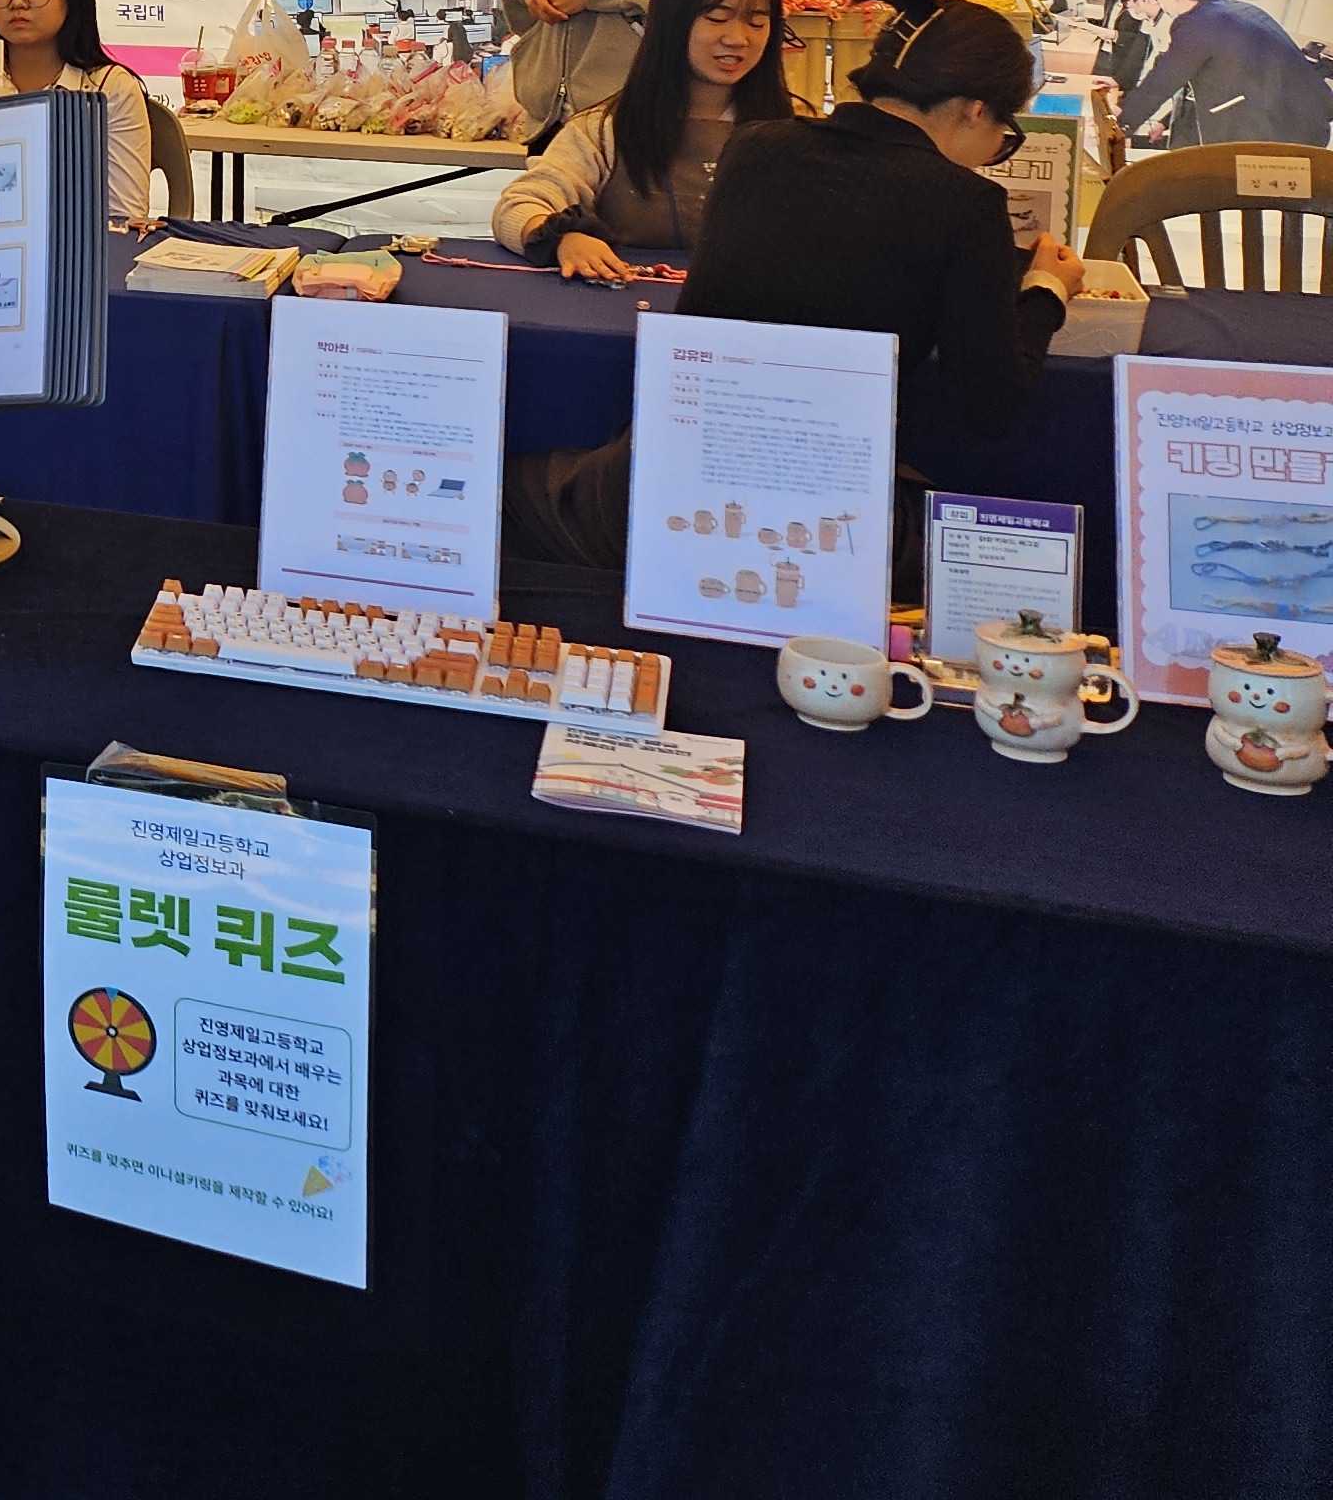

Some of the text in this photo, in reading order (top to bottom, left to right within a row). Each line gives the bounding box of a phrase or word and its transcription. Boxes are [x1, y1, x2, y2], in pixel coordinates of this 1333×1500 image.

[116, 4, 165, 21] 국립대
[1157, 412, 1263, 434] 진영제일고등학교
[1166, 440, 1242, 478] 키링
[130, 817, 271, 860] 진영제일고등학교
[159, 848, 247, 881] 상업정보과
[64, 875, 346, 985] 룰렛 퀴즈
[199, 1015, 325, 1056] 진영제일고등학교
[182, 1037, 342, 1086] 상업정보과에서 배우는
[218, 1069, 300, 1102] 과목에 대한
[194, 1087, 329, 1131] 퀴즈를 맞춰보세요!
[66, 1141, 102, 1163] 퀴즈를
[272, 1195, 284, 1209] 수
